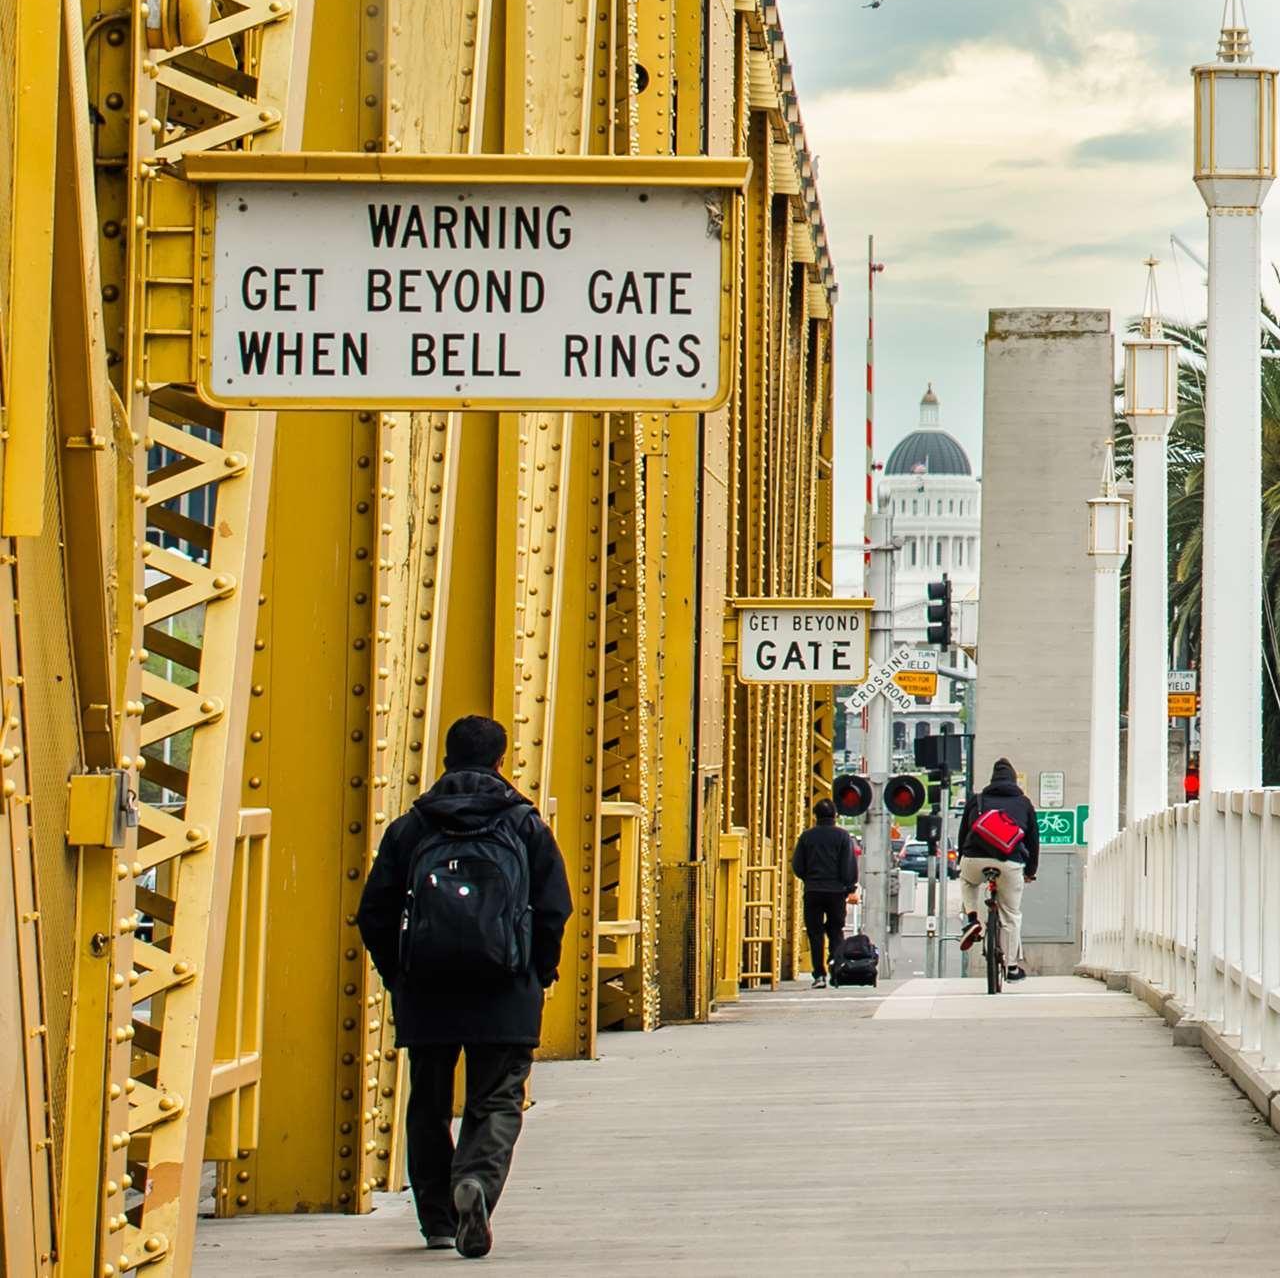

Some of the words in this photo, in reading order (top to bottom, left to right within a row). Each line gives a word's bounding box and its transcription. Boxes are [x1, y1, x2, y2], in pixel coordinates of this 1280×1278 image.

[368, 204, 571, 249] WARNING
[241, 266, 324, 311] GET
[367, 269, 545, 313] BEYOND
[588, 270, 692, 314] GATE
[238, 331, 367, 376] WHEN
[411, 333, 521, 376] BELL
[564, 334, 701, 377] RINGS
[749, 615, 778, 631] GET
[793, 616, 859, 631] BEYOND
[756, 640, 851, 671] GATE
[902, 661, 930, 669] IELD
[851, 650, 909, 708] CROSSING
[1168, 682, 1190, 690] YIELD
[884, 682, 911, 709] ROAD
